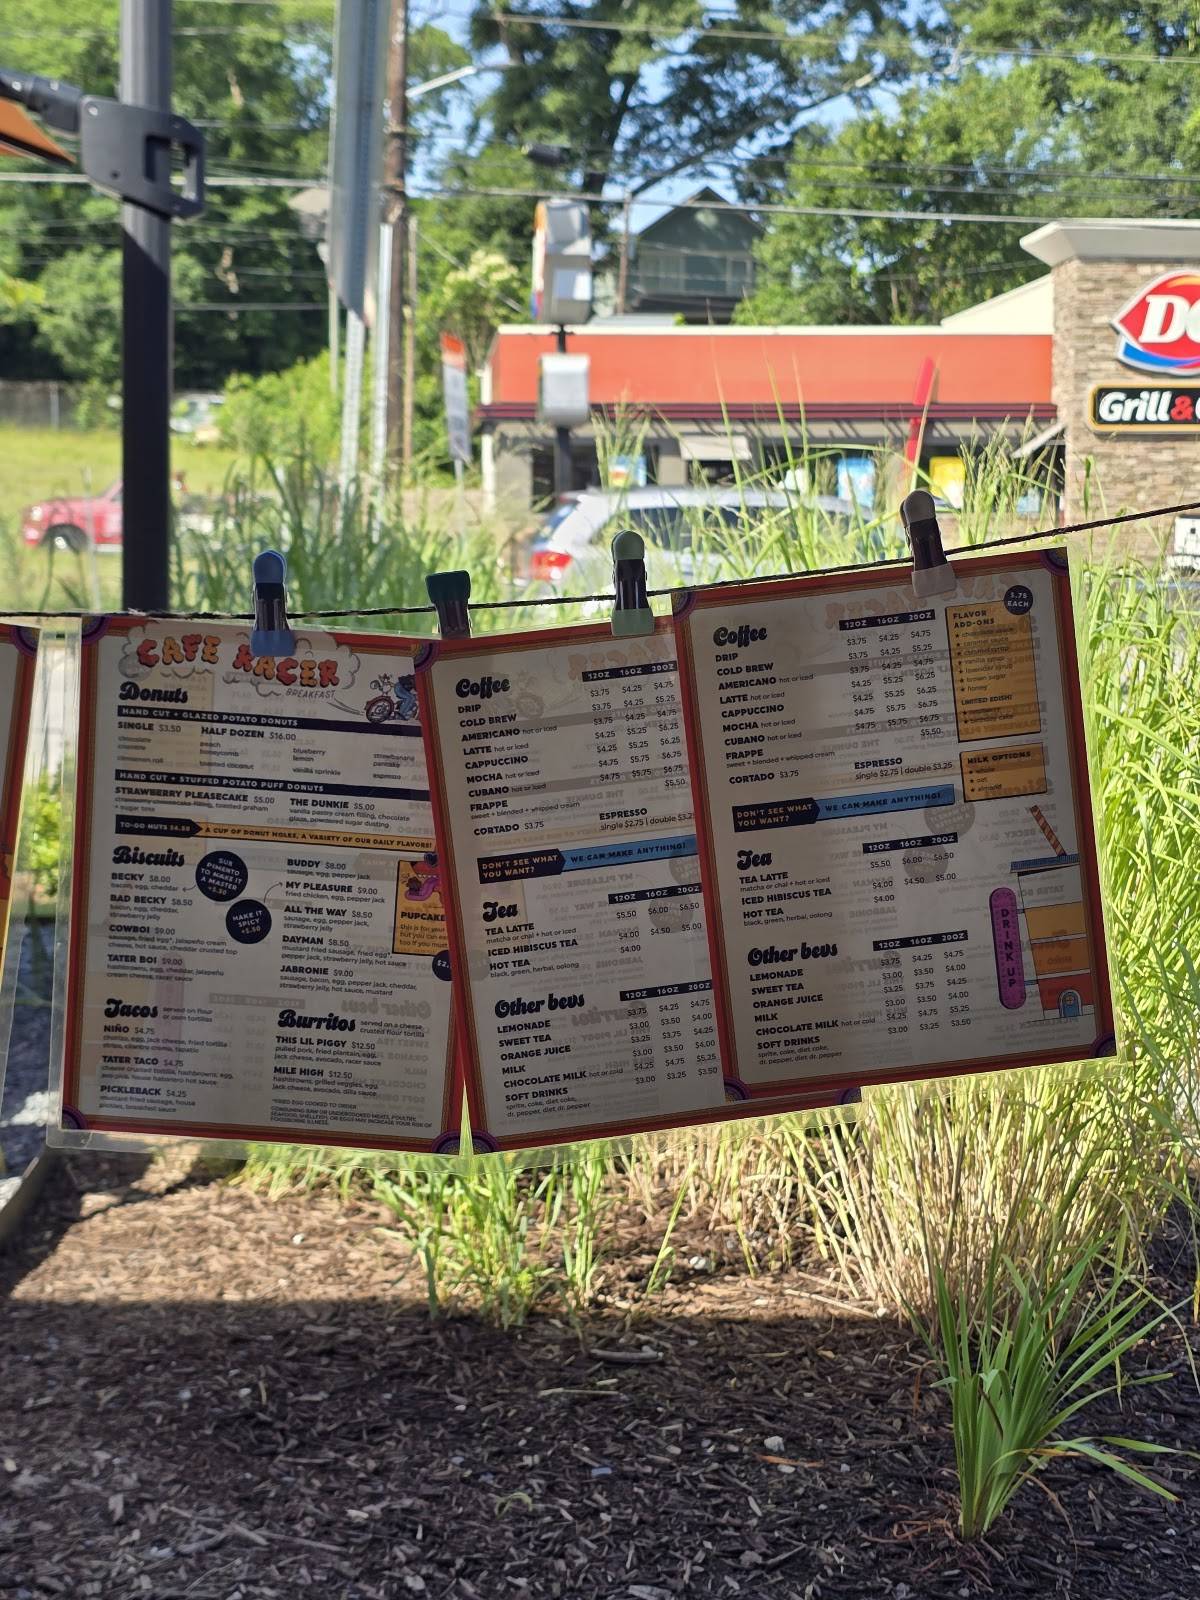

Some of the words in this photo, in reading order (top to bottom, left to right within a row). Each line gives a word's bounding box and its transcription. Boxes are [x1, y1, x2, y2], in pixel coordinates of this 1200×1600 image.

[1007, 598, 1028, 608] EACH
[952, 609, 986, 619] FLAVOR
[953, 617, 994, 628] ADD-ONS
[714, 625, 767, 649] Coffee
[135, 632, 221, 668] CAFE
[232, 644, 340, 688] RACER
[715, 652, 739, 662] DRIP
[716, 665, 743, 676] COLD
[745, 662, 774, 673] BREW
[456, 676, 510, 700] Coffee
[718, 676, 776, 690] AMERICANO
[119, 681, 188, 703] Donuts
[286, 687, 336, 700] BREAKFAST
[719, 693, 748, 704] LATTE
[457, 703, 481, 714] DRIP
[721, 703, 784, 718] CAPPUCCINO
[122, 707, 148, 715] HAND
[182, 711, 218, 720] GLAZED
[222, 714, 257, 722] POTATO
[261, 716, 297, 725] DONUTS
[459, 717, 486, 728] COLD
[488, 713, 517, 724] BREW
[117, 720, 154, 731] SINGLE
[158, 723, 181, 733] $3.50
[200, 726, 225, 736] HALF
[229, 728, 264, 739] DOZEN
[268, 730, 296, 741] $16.00
[722, 721, 759, 732] MOCHA
[461, 728, 520, 742] AMERICANO
[724, 734, 765, 746] CUBANO
[462, 745, 492, 755] LATTE
[725, 748, 764, 760] FRAPPE
[464, 755, 528, 770] CAPPUCCINO
[853, 757, 902, 769] ESPRESSO
[120, 771, 145, 779] HAND
[150, 773, 166, 781] CUT
[179, 775, 218, 784] STUFFED
[222, 778, 256, 787] POTATO
[261, 781, 285, 789] PUFF
[288, 782, 323, 791] DONUTS
[465, 772, 502, 784] MOCHA
[728, 771, 775, 784] CORTADO
[777, 768, 799, 778] $3.75
[115, 786, 181, 797] STRAWBERRY
[185, 790, 248, 802] PLEASECAKE
[253, 795, 274, 804] $5.00
[290, 797, 308, 806] THE
[311, 799, 349, 809] DUNKIE
[353, 802, 375, 810] $5.00
[467, 786, 509, 798] CUBANO
[469, 799, 508, 811] FRAPPE
[599, 808, 647, 820] ESPRESSO
[473, 823, 519, 836] CORTADO
[523, 820, 544, 830] $3.75
[868, 842, 890, 850] 12OZ
[900, 839, 922, 847] 16OZ
[932, 835, 954, 844] 20OZ
[113, 845, 185, 867] Biscuits
[737, 850, 772, 869] Tea
[286, 858, 320, 868] BUDDY
[324, 861, 346, 870] $8.00
[111, 872, 143, 881] BECKY
[149, 874, 170, 883] $8.00
[738, 874, 758, 884] TEA
[759, 871, 788, 882] LATTE
[285, 881, 300, 889] MY
[303, 882, 352, 893] PLEASURE
[357, 886, 378, 895] $9.00
[110, 894, 130, 902] BAD
[133, 895, 166, 905] BECKY
[171, 898, 192, 906] $8.50
[741, 894, 765, 905] ICED
[766, 890, 810, 902] HIBISCUS
[812, 887, 831, 898] TEA
[283, 904, 302, 914] ALL
[304, 906, 323, 915] THE
[325, 907, 347, 917] WAY
[352, 909, 372, 918] $8.50
[483, 901, 517, 921] Tea
[743, 909, 763, 919] HOT
[764, 907, 784, 916] TEA
[873, 893, 894, 903] $4.00
[109, 924, 149, 933] COWBOI
[153, 927, 175, 935] $9.00
[485, 925, 504, 935] TEA
[506, 922, 534, 933] LATTE
[282, 935, 323, 945] DAYMAN
[328, 938, 349, 946] $8.50
[487, 946, 510, 956] ICED
[513, 941, 557, 953] HIBISCUS
[559, 938, 578, 948] TEA
[1000, 907, 1014, 961] DRINK
[1007, 970, 1017, 988] UP
[107, 953, 135, 962] TATER
[139, 955, 157, 963] BOI
[161, 957, 182, 965] $9.00
[748, 946, 797, 966] Other
[801, 942, 838, 960] bevs
[280, 965, 328, 975] JABRONIE
[332, 968, 353, 977] $9.00
[489, 960, 509, 970] HOT
[512, 958, 529, 968] TEA
[749, 968, 804, 981] LEMONADE
[751, 984, 783, 995] SWEET
[785, 982, 804, 991] TEA
[495, 997, 545, 1017] Other
[548, 993, 584, 1011] bevs
[753, 996, 793, 1008] ORANGE
[795, 993, 823, 1004] JUICE
[105, 998, 158, 1020] Tacos
[278, 1009, 356, 1031] Burritos
[754, 1012, 778, 1022] MILK
[103, 1023, 129, 1033] NIÑO
[134, 1025, 154, 1035] $4.75
[497, 1019, 551, 1033] LEMONADE
[755, 1022, 813, 1036] CHOCOLATE
[814, 1019, 838, 1030] MILK
[275, 1036, 297, 1044] THIS
[299, 1037, 313, 1045] LIL
[316, 1039, 346, 1048] PIGGY
[351, 1041, 375, 1049] $12.50
[498, 1036, 531, 1047] SWEET
[533, 1033, 551, 1043] TEA
[757, 1039, 782, 1049] SOFT
[783, 1035, 820, 1046] DRINKS
[500, 1048, 541, 1060] ORANGE
[543, 1045, 571, 1056] JUICE
[102, 1054, 131, 1063] TATER
[133, 1056, 159, 1065] TACO
[163, 1058, 183, 1067] $4.75
[273, 1066, 296, 1074] MILE
[299, 1067, 323, 1076] HIGH
[328, 1069, 352, 1078] $12.50
[501, 1064, 526, 1074] MILK
[503, 1074, 560, 1088] CHOCOLATE
[562, 1071, 587, 1082] MILK
[100, 1084, 161, 1095] PICKLEBACK
[166, 1089, 187, 1097] $4.25
[504, 1091, 529, 1101] SOFT
[530, 1087, 568, 1099] DRINKS
